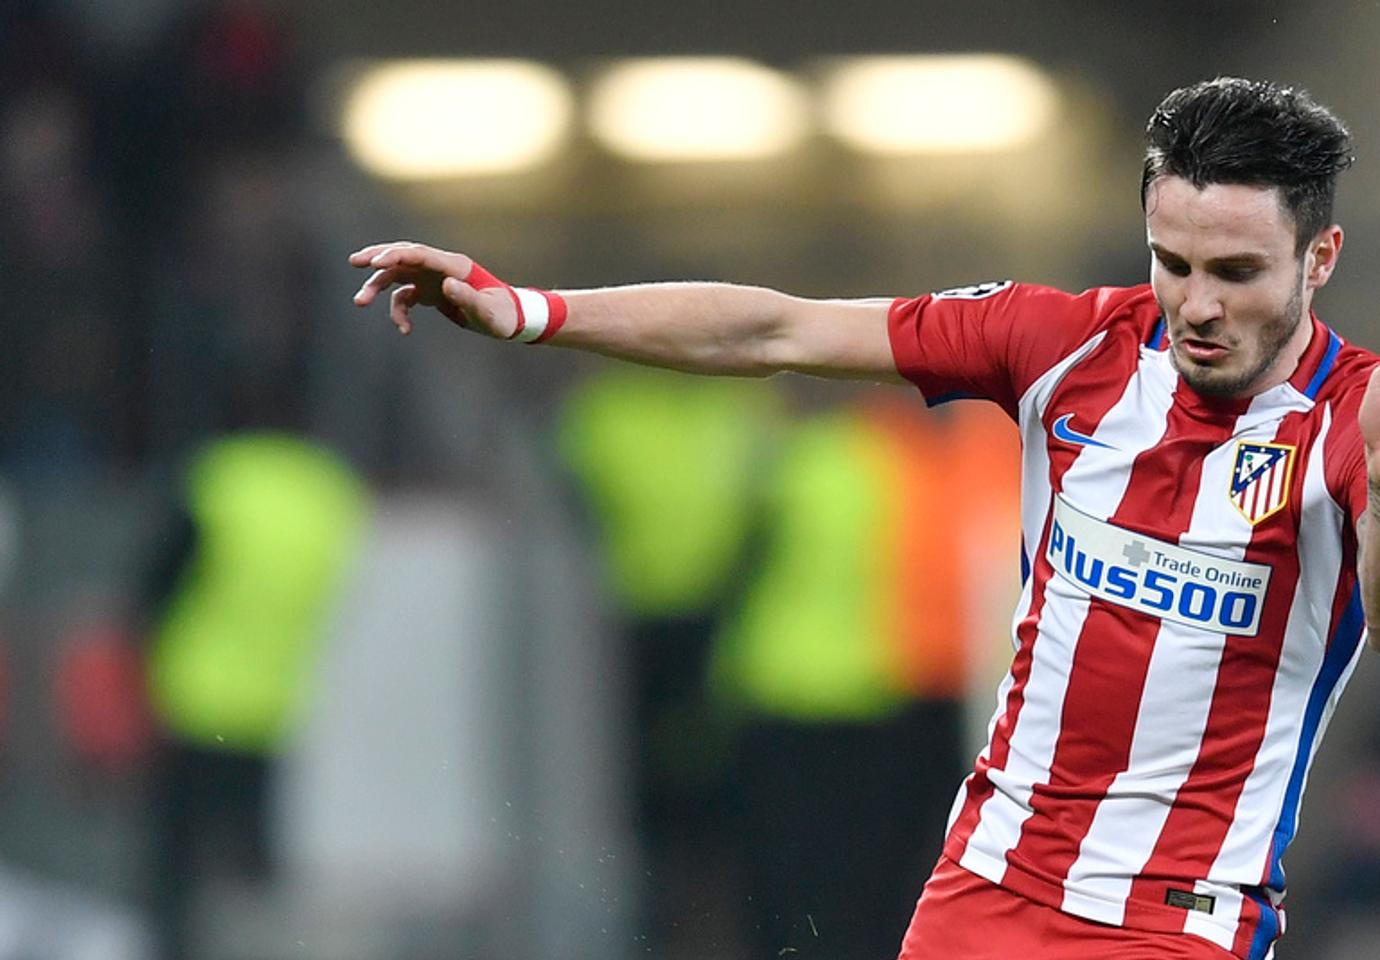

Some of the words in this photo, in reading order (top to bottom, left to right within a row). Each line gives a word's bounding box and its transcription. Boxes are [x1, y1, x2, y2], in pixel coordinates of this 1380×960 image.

[1049, 517, 1257, 629] Plus500
[1154, 551, 1201, 578] Trade
[1205, 567, 1262, 589] Online
